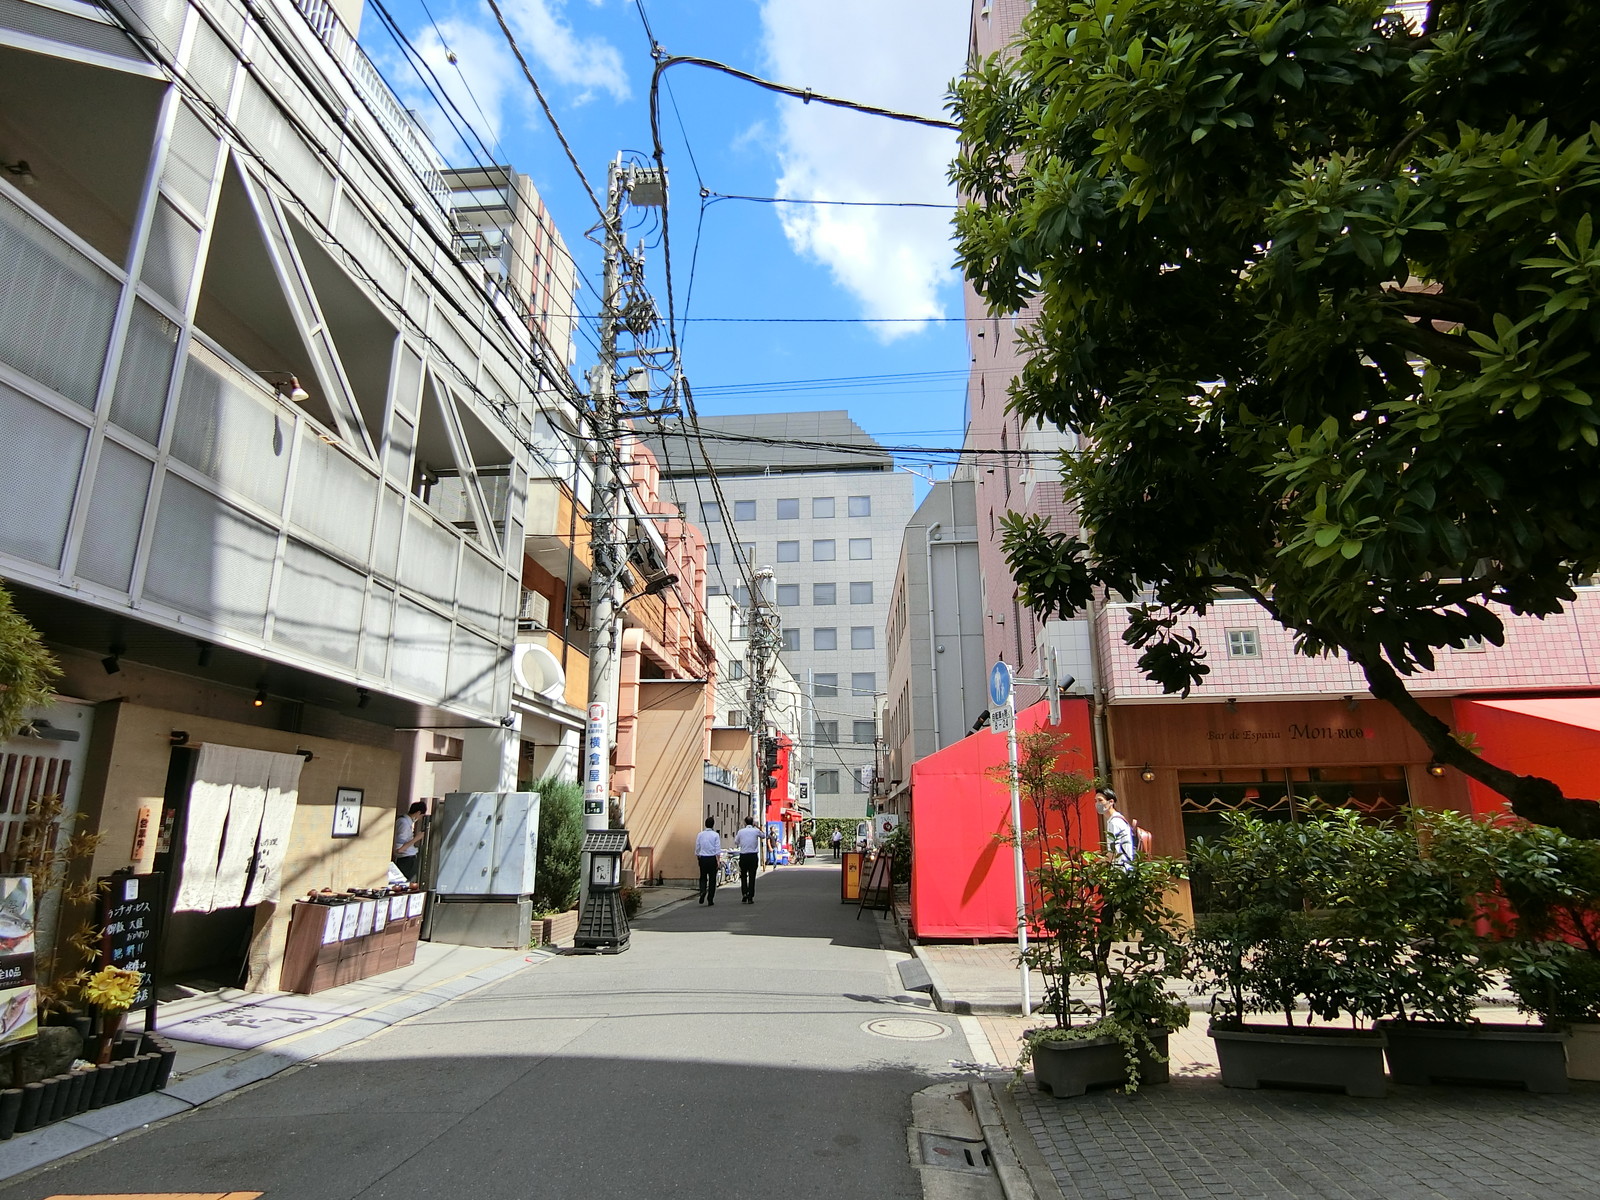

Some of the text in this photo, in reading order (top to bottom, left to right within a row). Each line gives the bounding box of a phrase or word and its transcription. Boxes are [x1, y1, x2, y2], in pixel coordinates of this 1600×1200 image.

[1207, 730, 1226, 740] Bar
[1229, 729, 1240, 740] de
[1243, 730, 1281, 744] España
[589, 736, 600, 781] 横倉屋
[108, 902, 151, 918] ランチサービス
